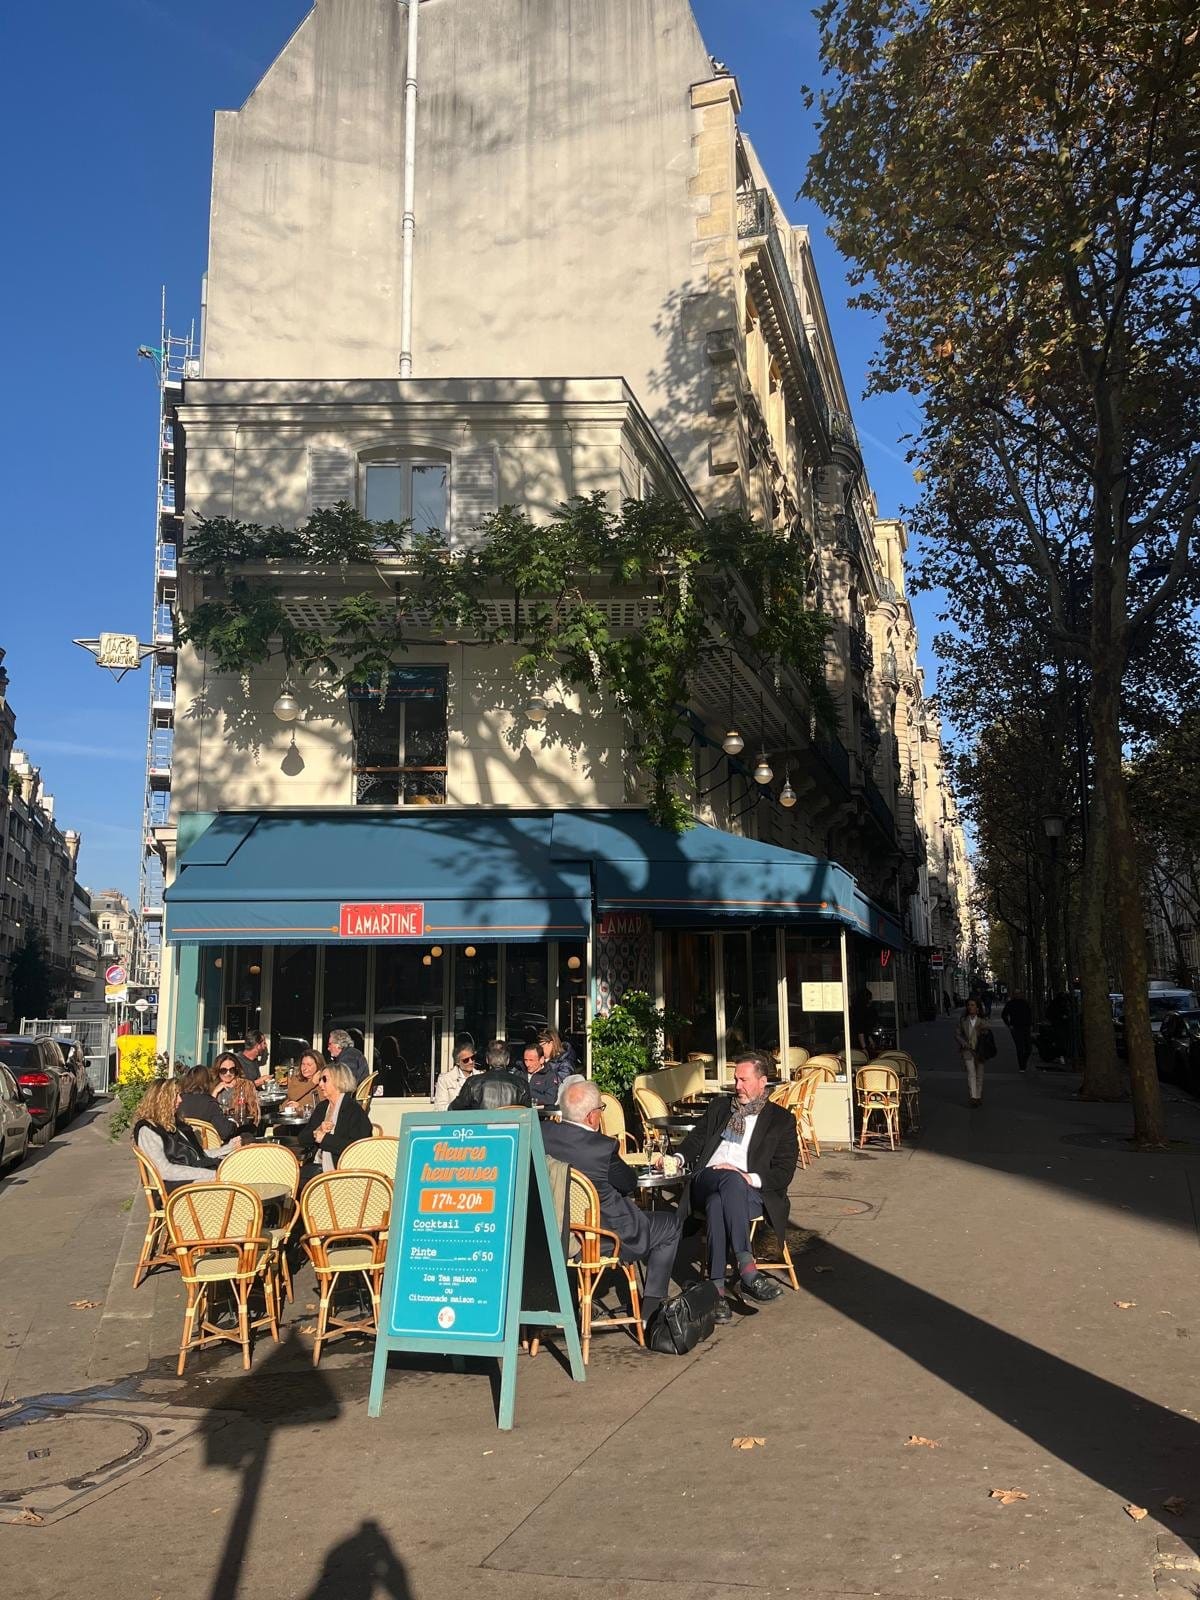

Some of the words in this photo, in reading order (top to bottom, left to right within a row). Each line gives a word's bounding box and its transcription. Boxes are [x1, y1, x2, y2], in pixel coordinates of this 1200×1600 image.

[347, 913, 417, 935] LAMARTINE
[433, 1141, 486, 1162] Heures
[421, 1161, 498, 1183] heureuses
[413, 1219, 460, 1229] Cocktail
[410, 1247, 437, 1257] Pinte
[438, 1274, 450, 1282] Tea
[453, 1275, 478, 1284] maison
[408, 1294, 448, 1303] Citronnade
[450, 1296, 475, 1304] maison
